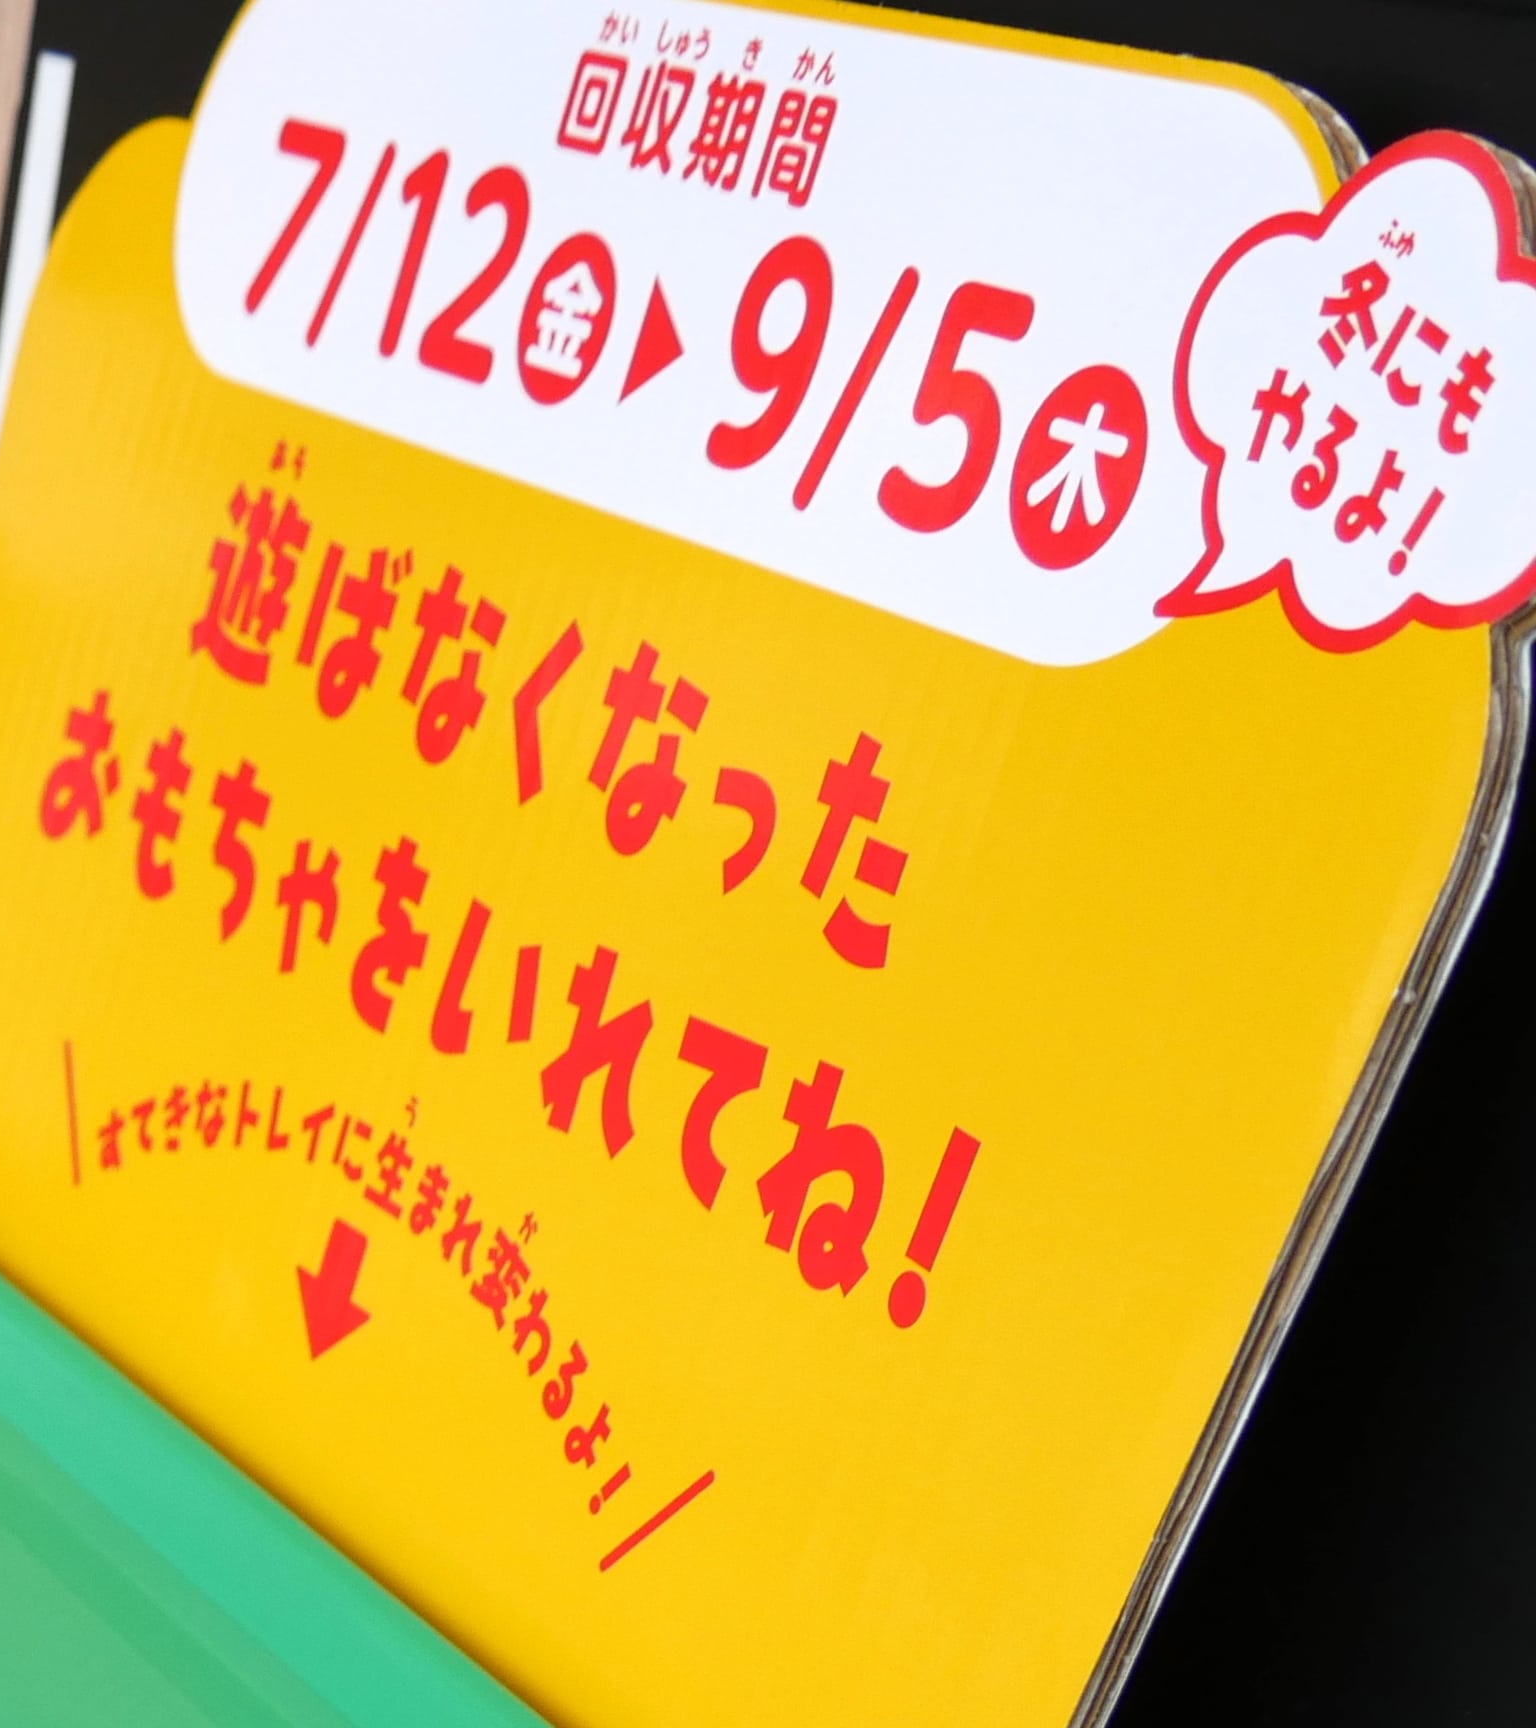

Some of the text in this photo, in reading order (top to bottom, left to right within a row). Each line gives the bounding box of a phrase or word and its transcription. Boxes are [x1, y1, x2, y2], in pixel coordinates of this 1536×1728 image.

[556, 49, 839, 208] 回収期間
[1246, 367, 1447, 577] やるよ!
[1317, 260, 1497, 456] 冬にも
[189, 482, 910, 970] 遊ばなくなった
[40, 688, 981, 1330] おもちゃをいれてね!
[95, 1077, 632, 1515] すてきなトレイに生まれ変わるよ!
